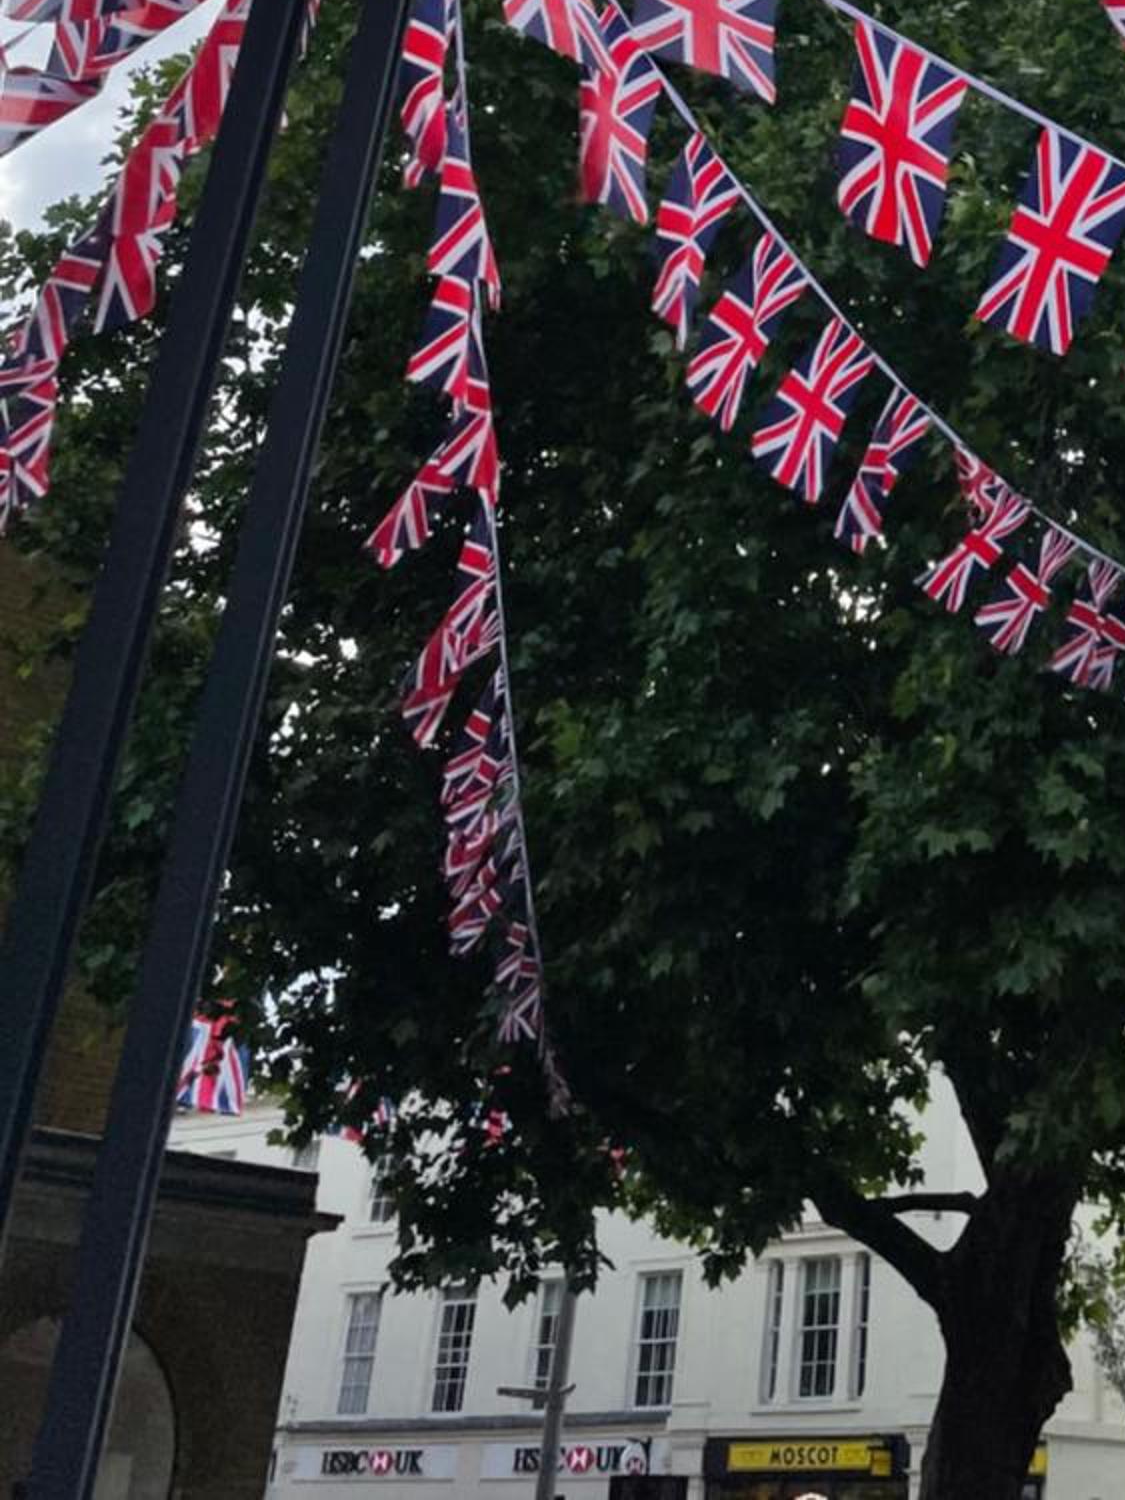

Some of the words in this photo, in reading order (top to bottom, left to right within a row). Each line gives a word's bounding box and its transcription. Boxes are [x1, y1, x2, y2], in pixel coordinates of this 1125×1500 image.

[321, 1450, 369, 1474] HSBC
[395, 1450, 423, 1474] UK
[769, 1446, 839, 1465] MOSCOT
